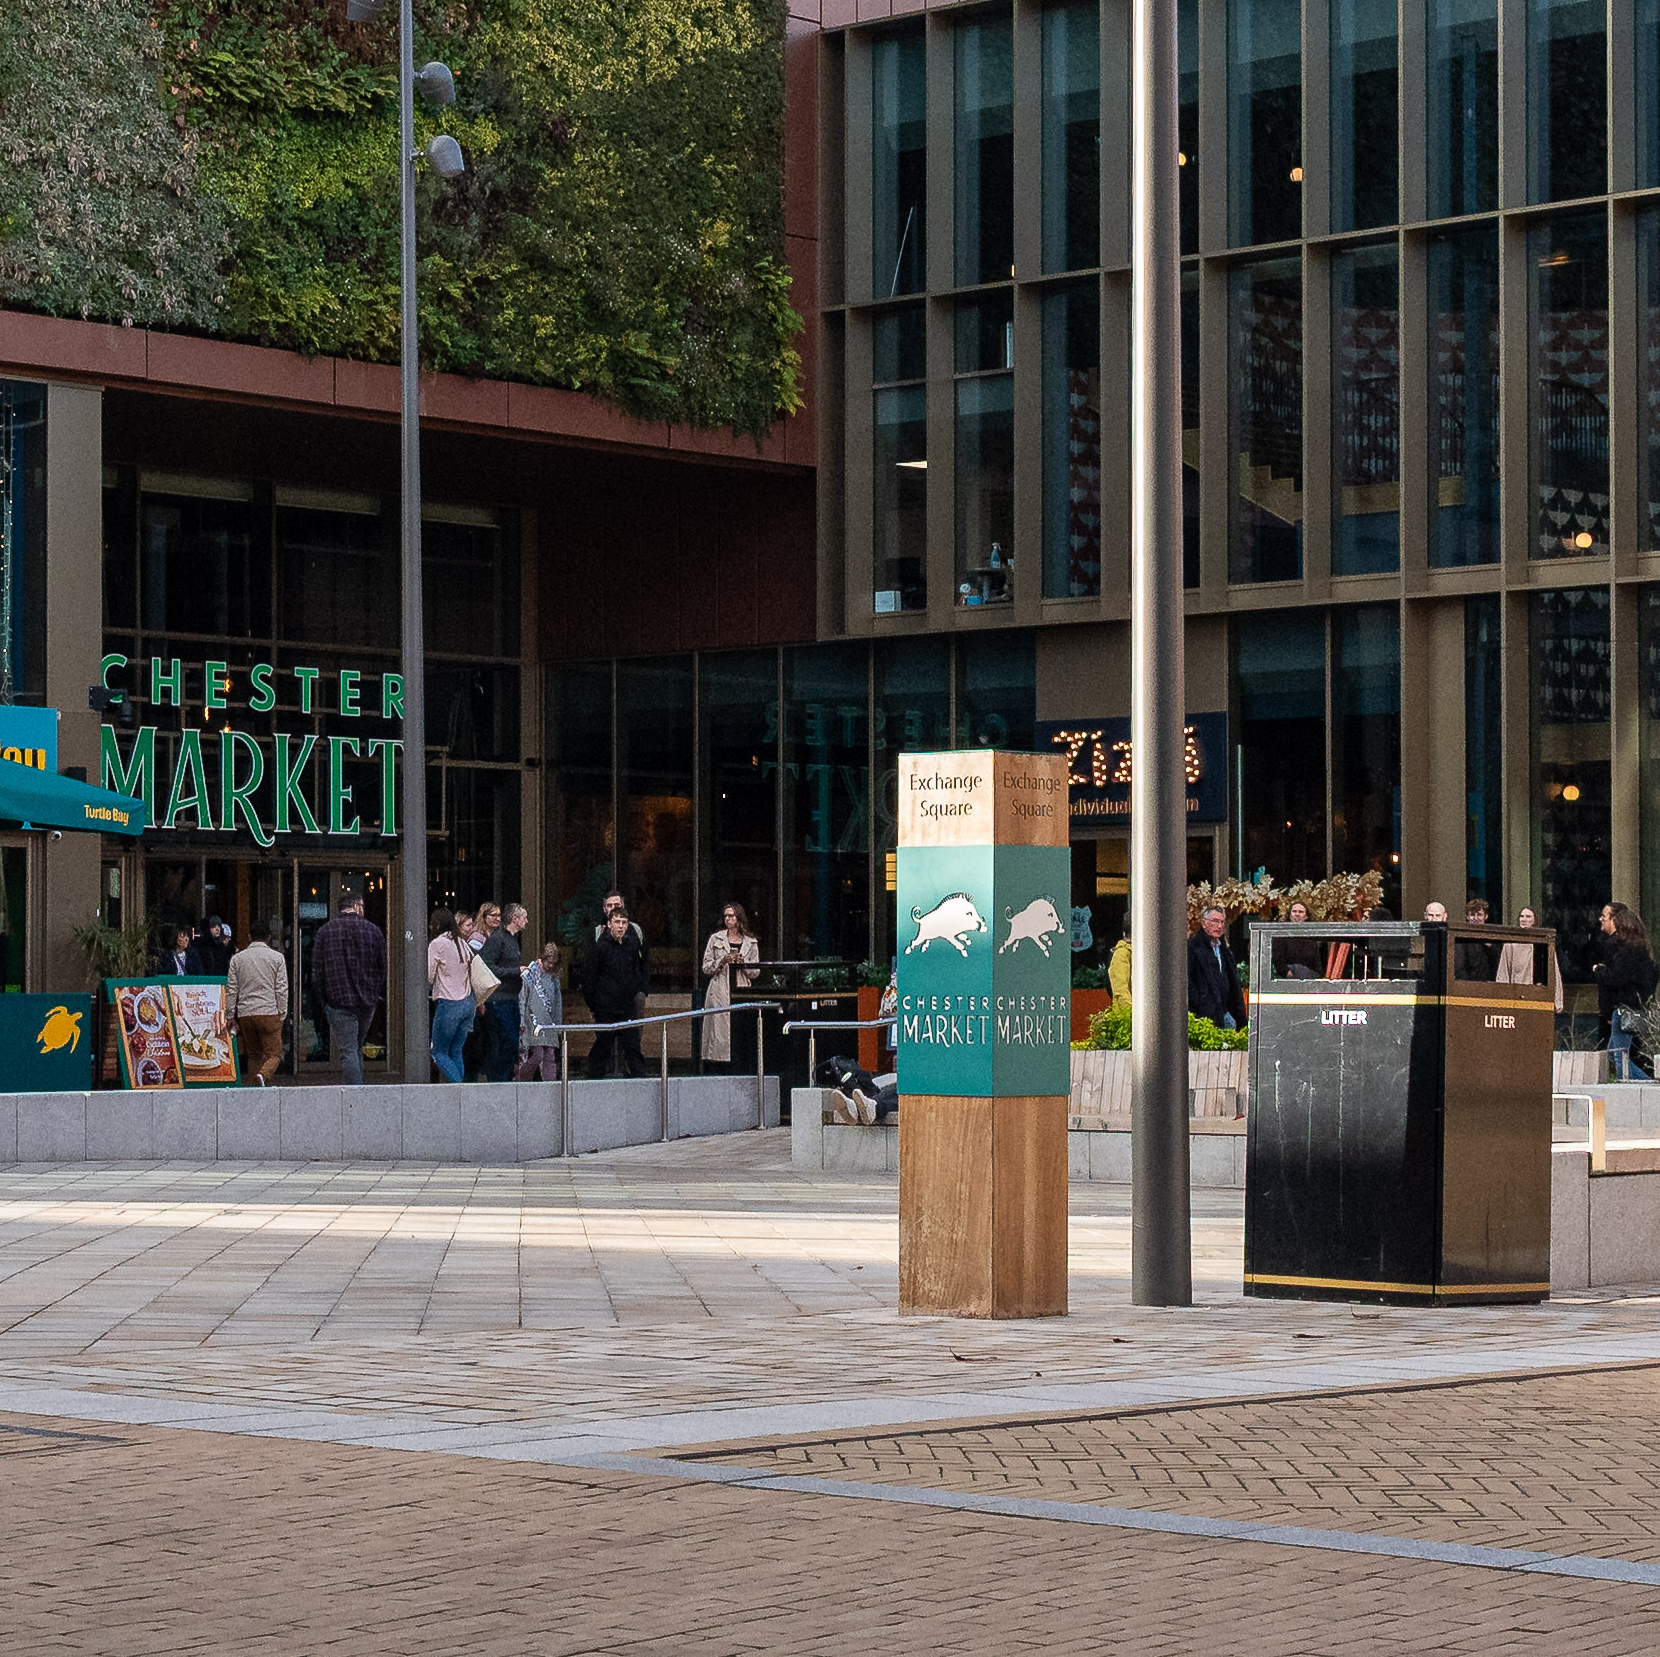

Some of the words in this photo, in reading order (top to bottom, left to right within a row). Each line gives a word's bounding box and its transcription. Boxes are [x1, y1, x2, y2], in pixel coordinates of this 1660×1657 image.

[101, 653, 404, 719] CHESTER
[1052, 726, 1205, 784] Zizi
[101, 724, 404, 847] MARKET
[910, 772, 983, 793] Exchange
[1003, 771, 1061, 795] Exchange
[83, 804, 112, 821] Turtle
[112, 807, 129, 827] Bay
[920, 800, 973, 821] Square
[1011, 799, 1054, 820] Square
[902, 995, 990, 1011] CHESTER
[997, 995, 1067, 1011] CHESTER
[1321, 1010, 1368, 1025] LITTER
[1484, 1015, 1516, 1029] LITTER
[903, 1014, 990, 1048] MARKET
[997, 1014, 1067, 1048] MARKET
